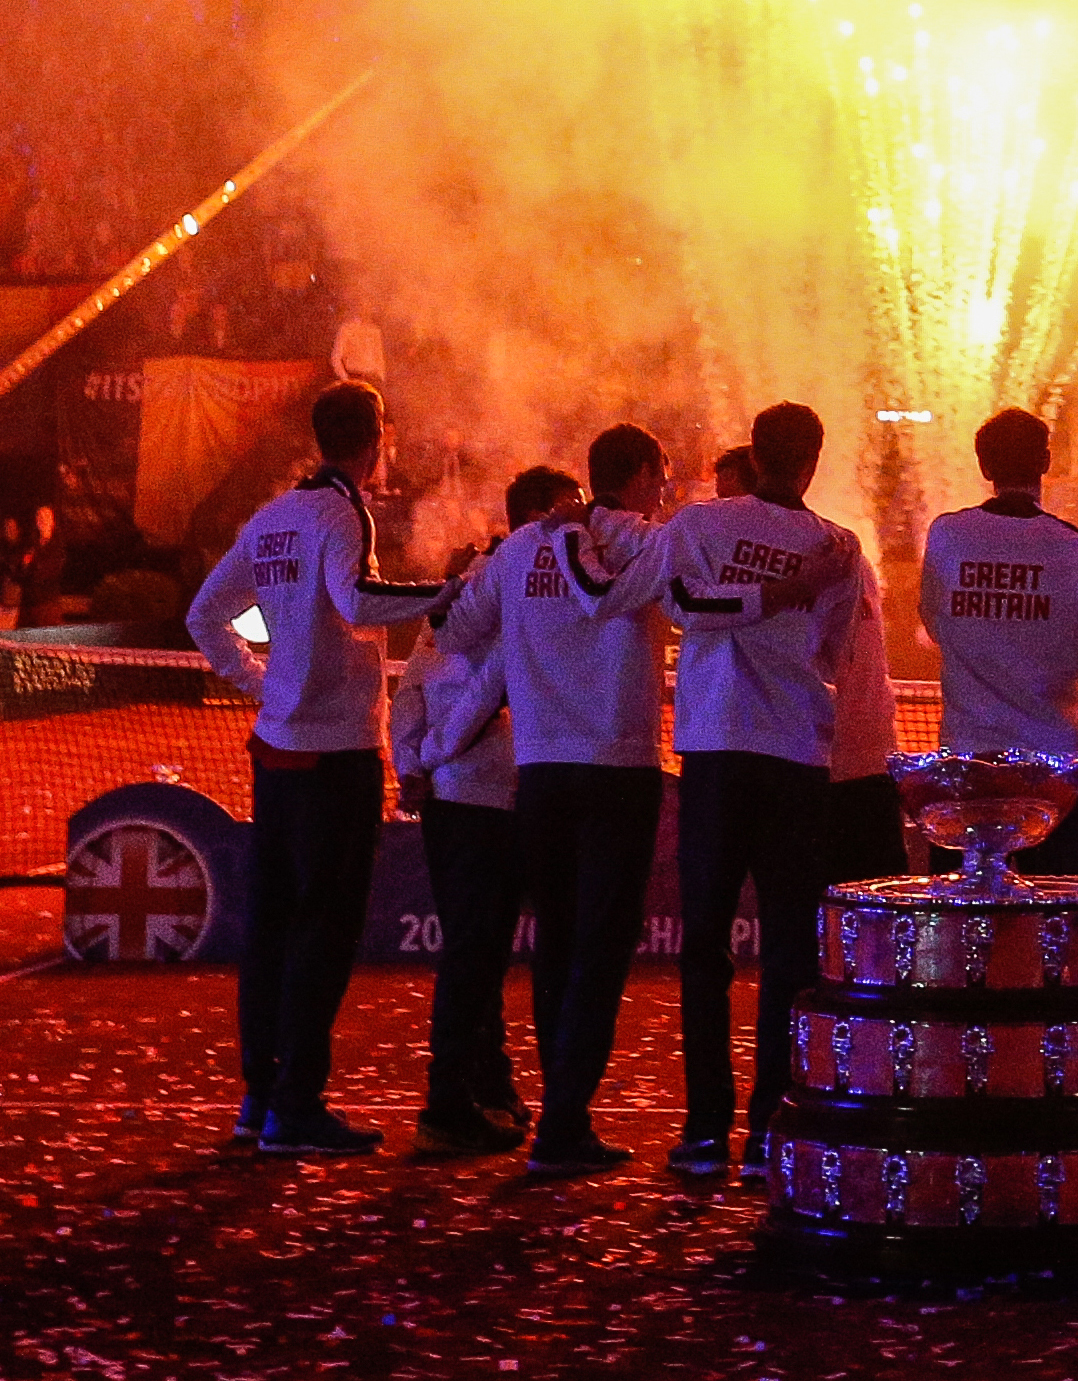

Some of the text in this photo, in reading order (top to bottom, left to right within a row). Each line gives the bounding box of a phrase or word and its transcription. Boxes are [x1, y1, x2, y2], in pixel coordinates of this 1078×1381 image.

[732, 539, 802, 576] GREA
[959, 562, 1044, 590] GREAT
[951, 590, 1050, 620] BRITAIN
[399, 913, 443, 952] 20
